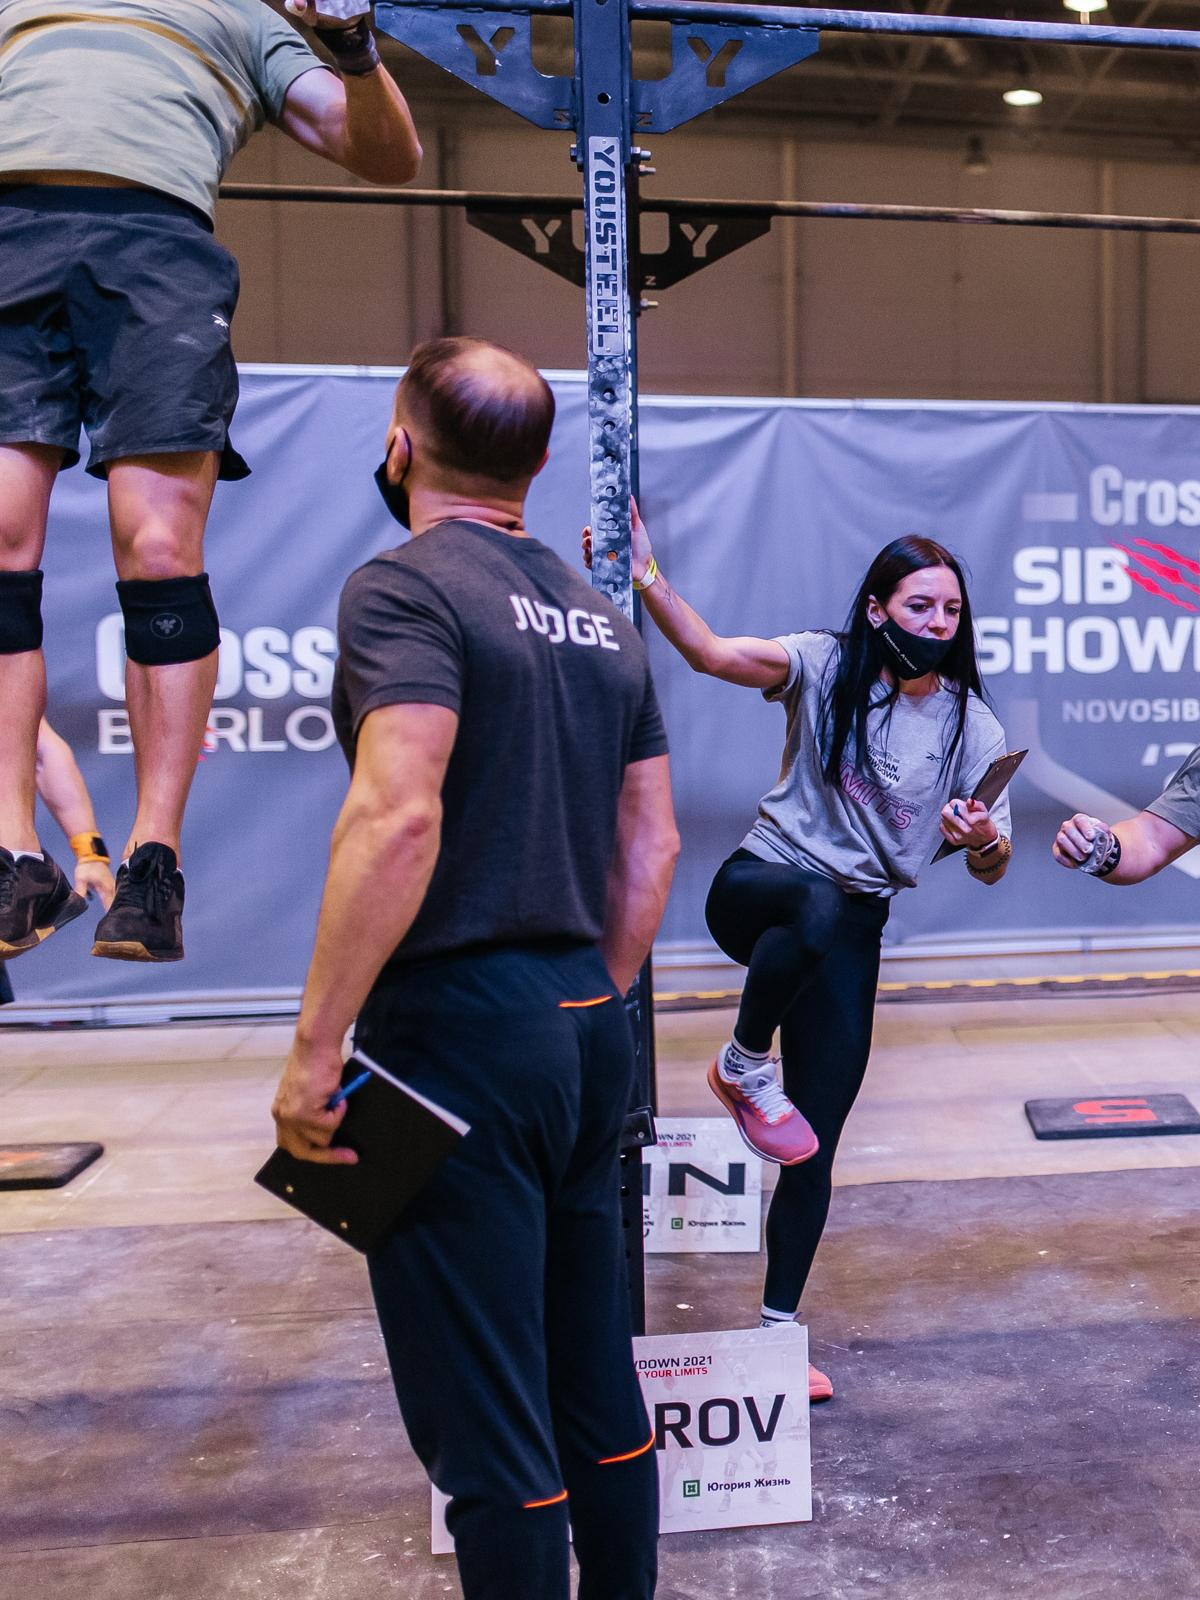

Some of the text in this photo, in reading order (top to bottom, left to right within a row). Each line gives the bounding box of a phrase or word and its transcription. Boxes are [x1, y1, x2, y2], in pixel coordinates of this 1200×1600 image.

[593, 144, 619, 348] YOUSTEEL
[509, 595, 620, 651] JUDGE
[635, 1355, 713, 1370] DOWN 2021
[644, 1369, 673, 1379] YOUR
[674, 1366, 709, 1377] LIMITS
[707, 1478, 791, 1492] Югория Жизнь
